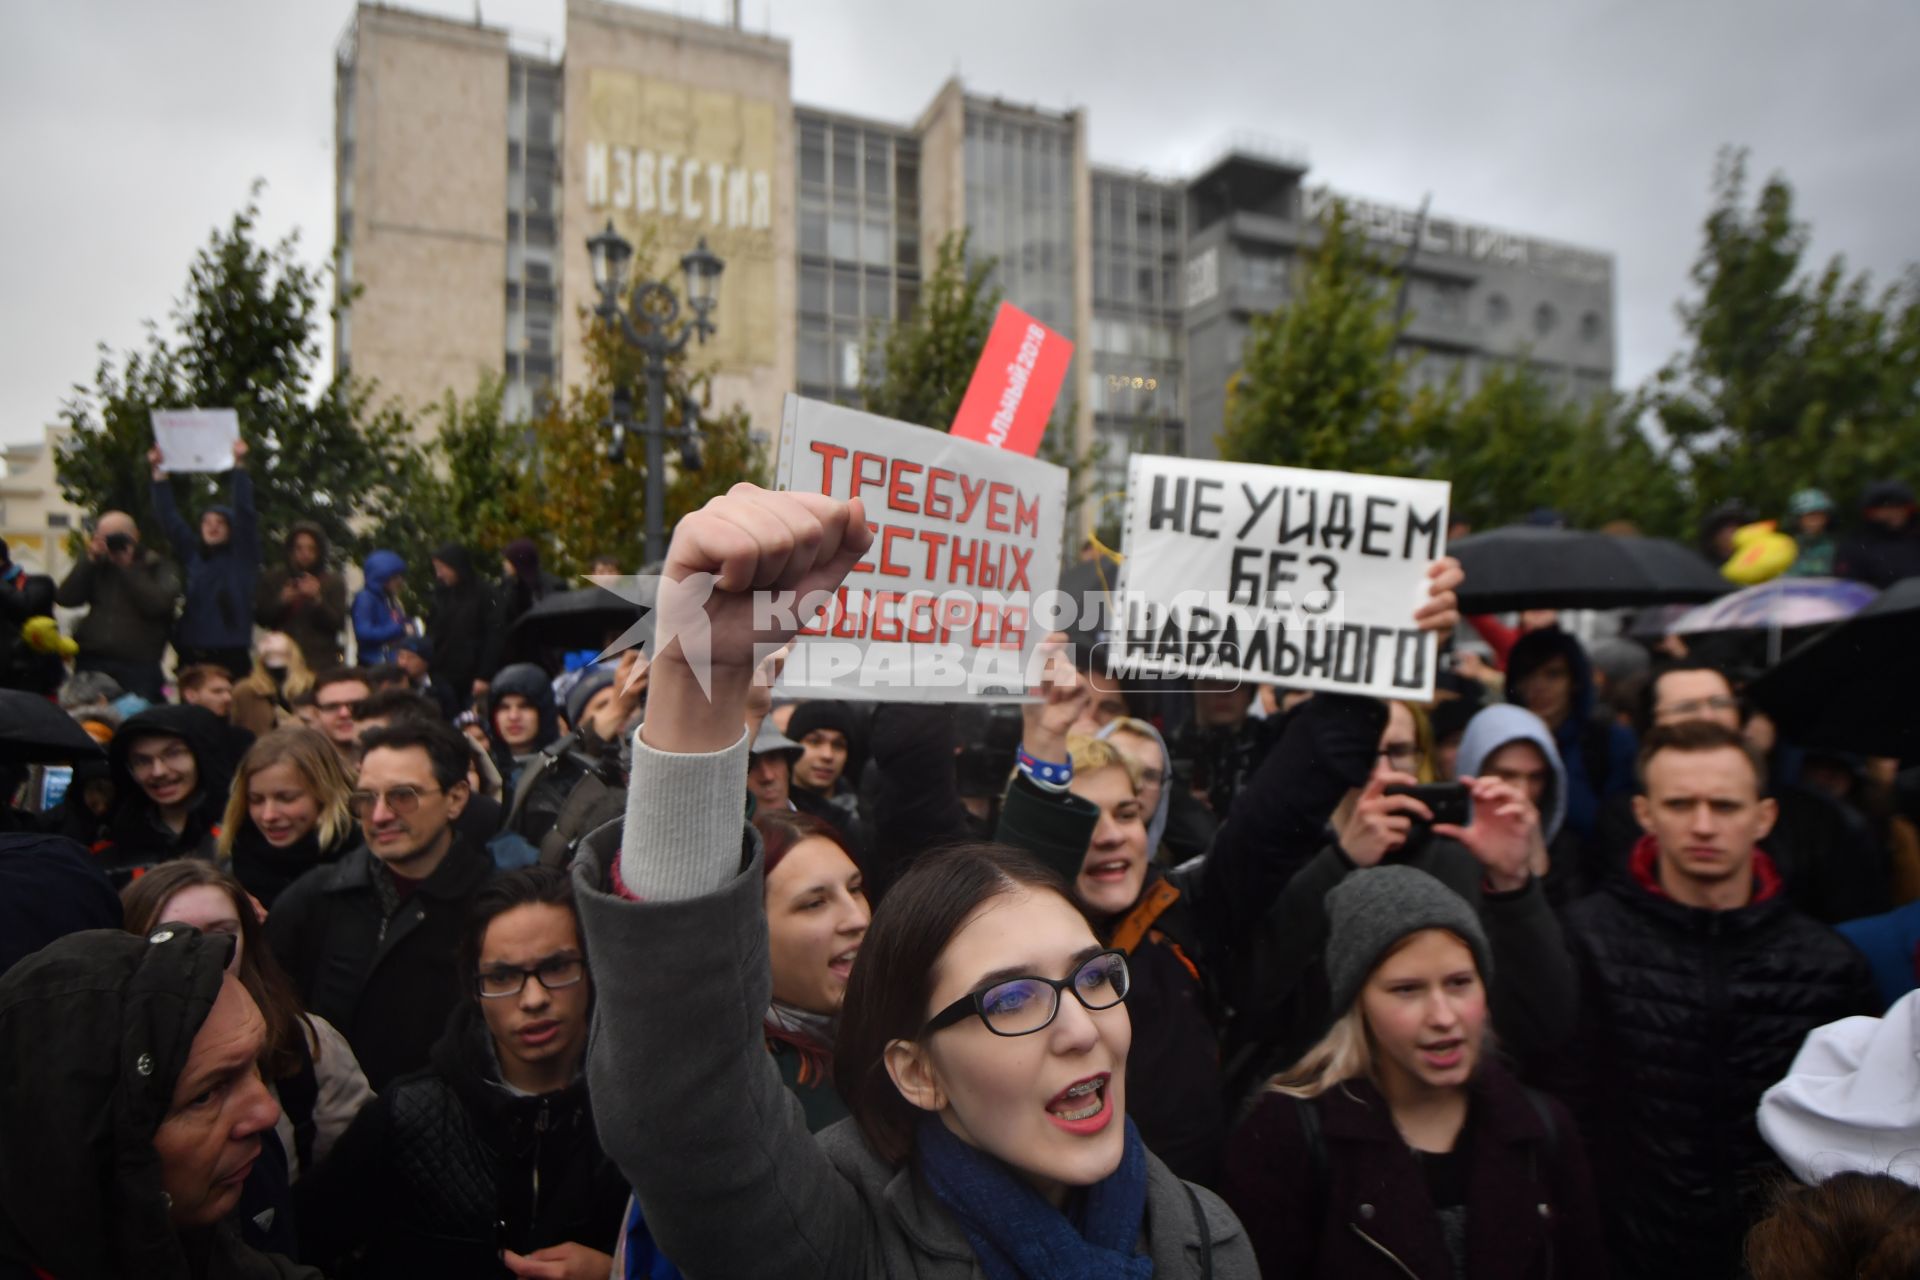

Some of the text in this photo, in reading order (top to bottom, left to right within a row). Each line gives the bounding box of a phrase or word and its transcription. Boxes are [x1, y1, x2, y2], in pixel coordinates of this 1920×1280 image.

[586, 143, 771, 228] ИЗВЕСТИЯ
[810, 440, 1040, 538] ТРЕБУЕМ
[1149, 474, 1443, 560] НЕ УЙДЕМ
[851, 521, 1033, 591] СТНЫХ
[1228, 545, 1341, 614] БЕЗ
[1127, 600, 1428, 689] НАВАЛЬНОГО
